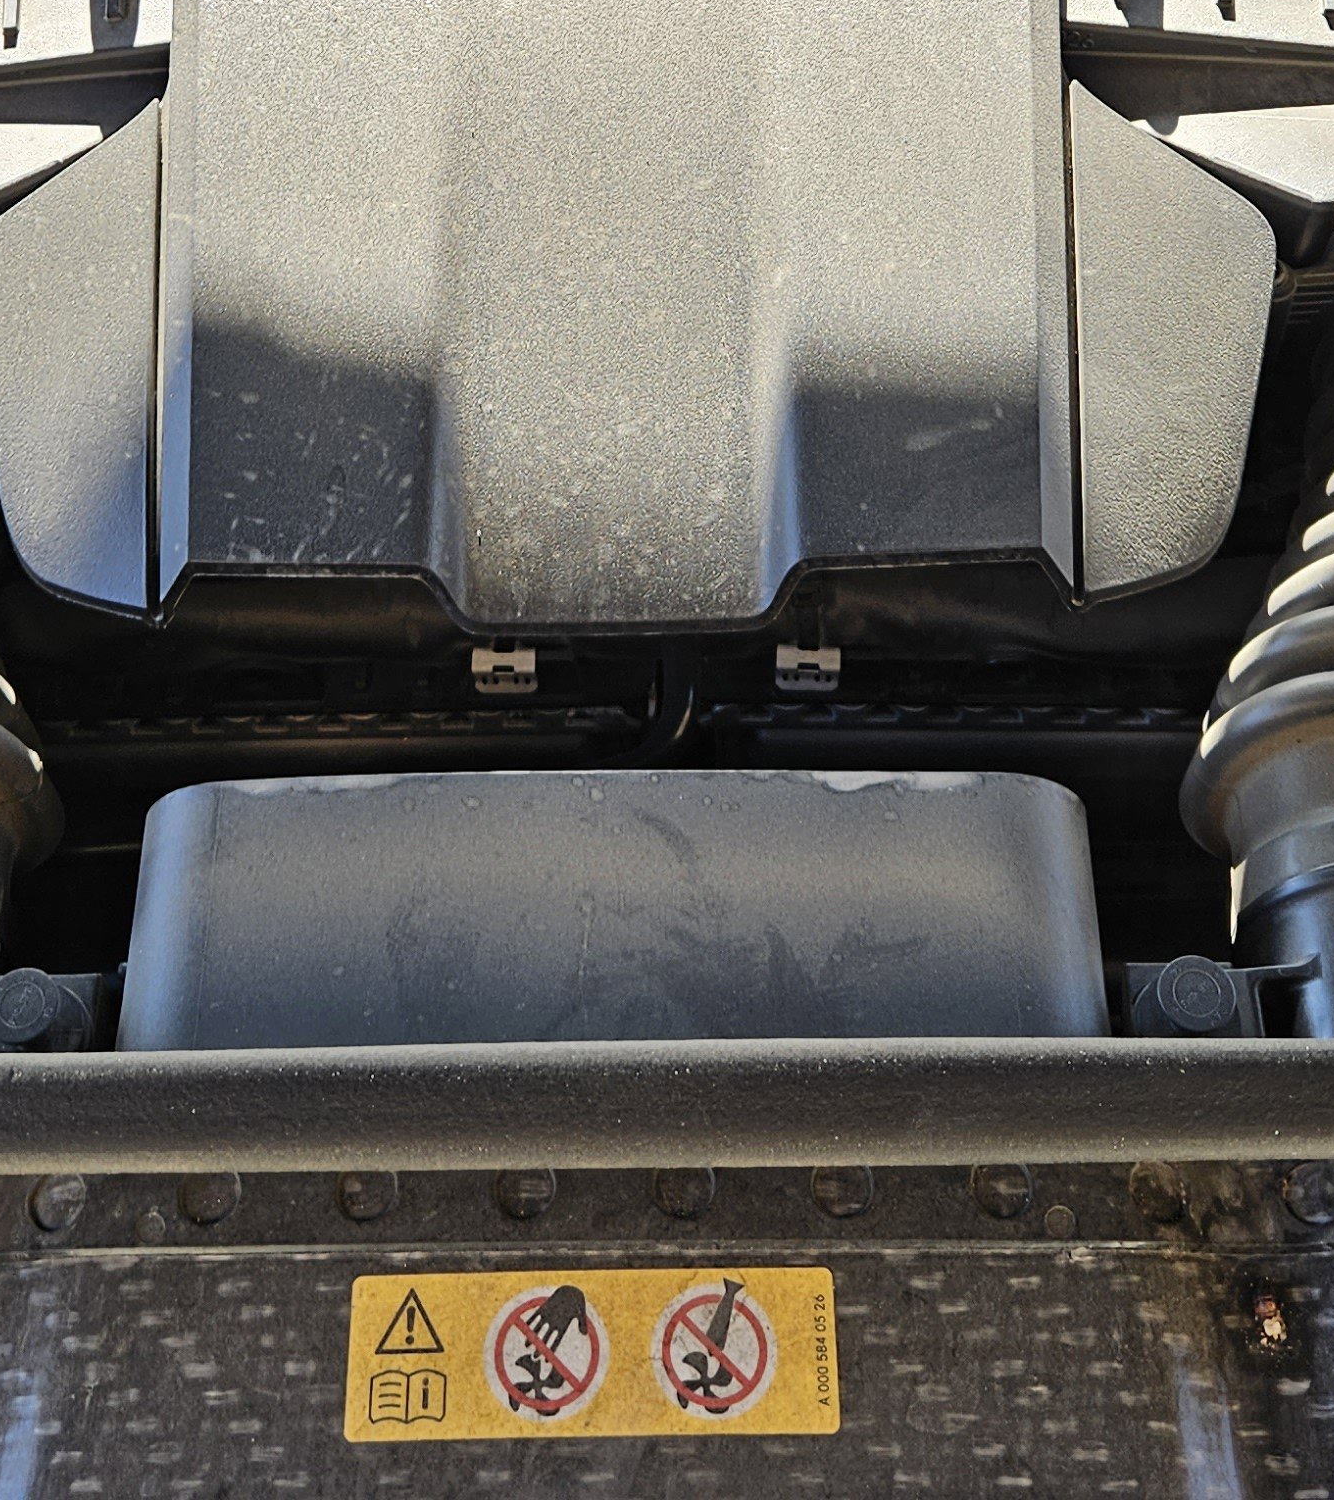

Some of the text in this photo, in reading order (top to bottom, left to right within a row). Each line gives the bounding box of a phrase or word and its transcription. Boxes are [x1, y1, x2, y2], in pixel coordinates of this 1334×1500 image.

[813, 1294, 831, 1407] A 000 584 05 26
